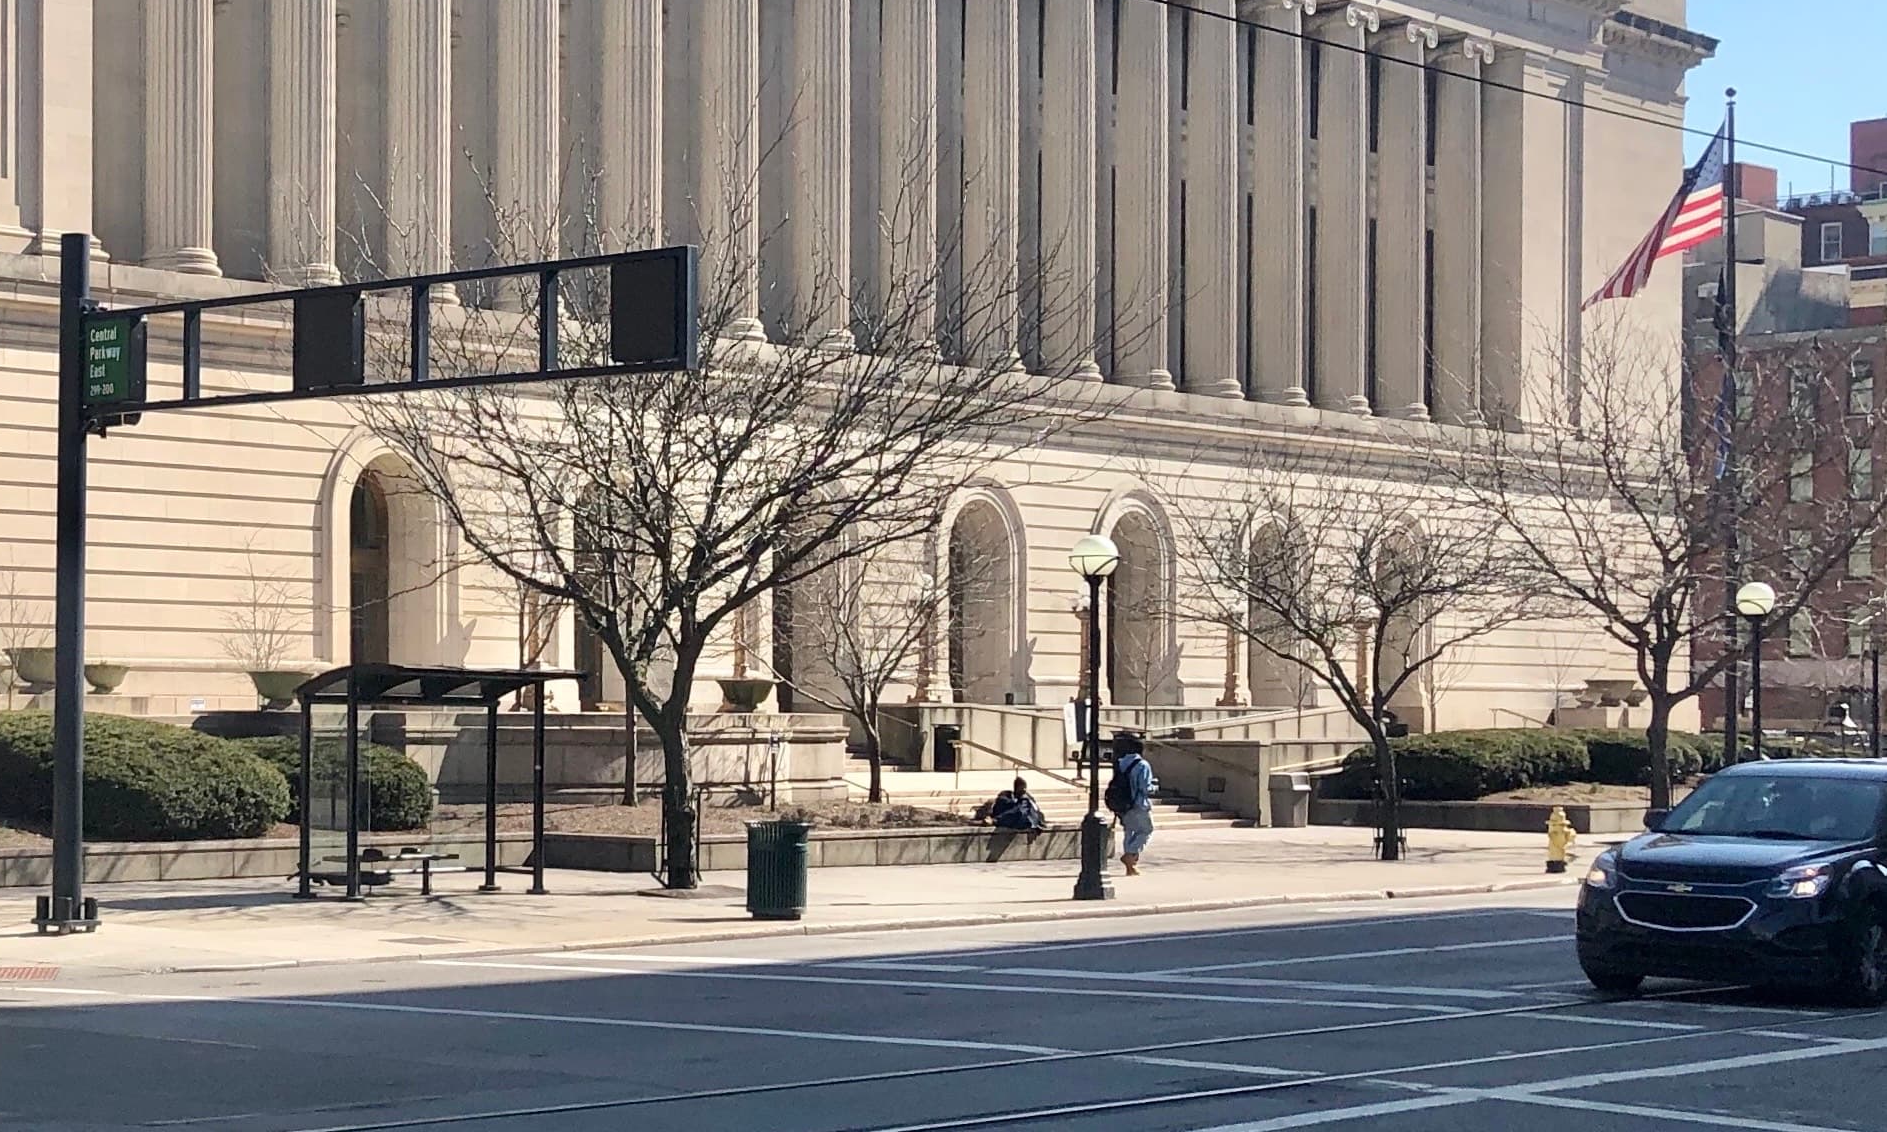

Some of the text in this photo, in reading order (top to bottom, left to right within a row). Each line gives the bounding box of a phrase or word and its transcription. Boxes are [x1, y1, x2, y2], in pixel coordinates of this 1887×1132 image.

[90, 326, 117, 343] Central
[90, 345, 121, 362] Parkway
[90, 363, 106, 379] East
